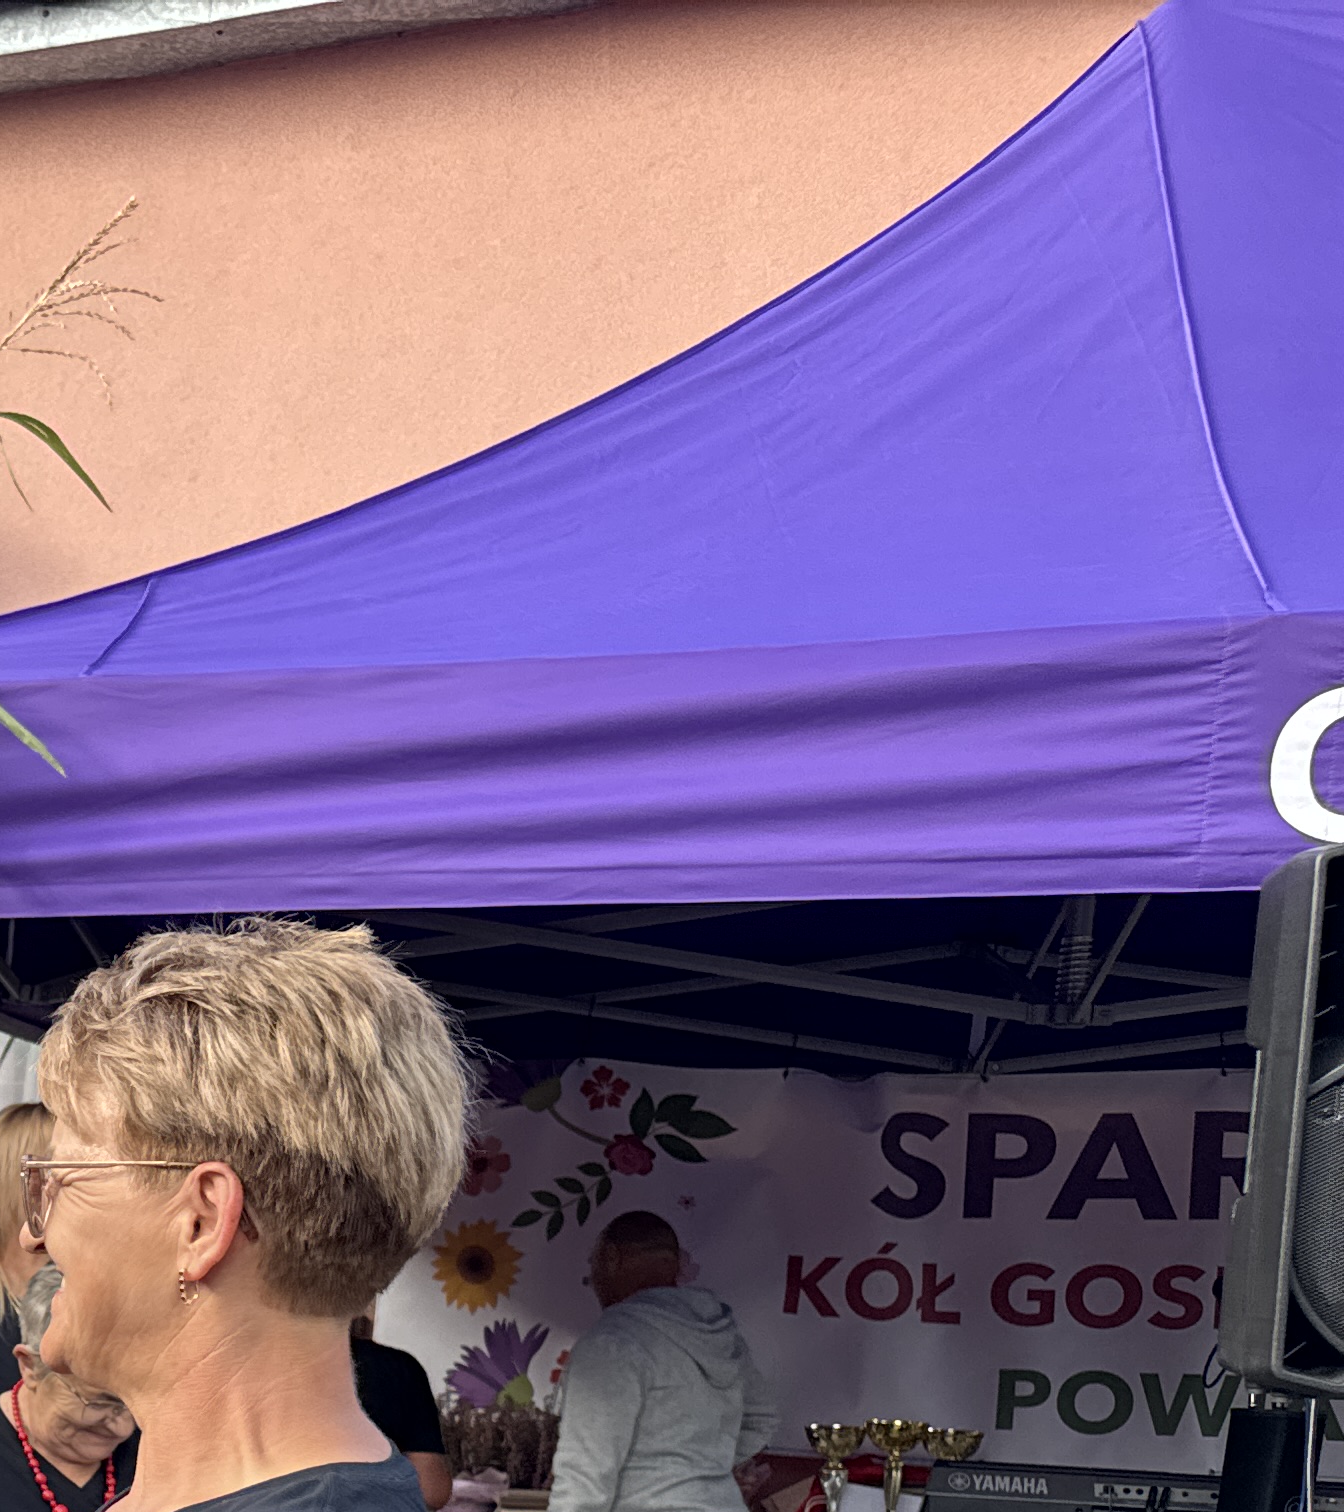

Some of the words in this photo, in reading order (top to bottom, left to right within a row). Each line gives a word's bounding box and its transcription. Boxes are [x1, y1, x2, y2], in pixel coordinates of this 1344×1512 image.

[782, 1242, 961, 1326] KÓŁ
[990, 1262, 1225, 1331] GOS
[972, 1473, 1049, 1495] YAMAHA
